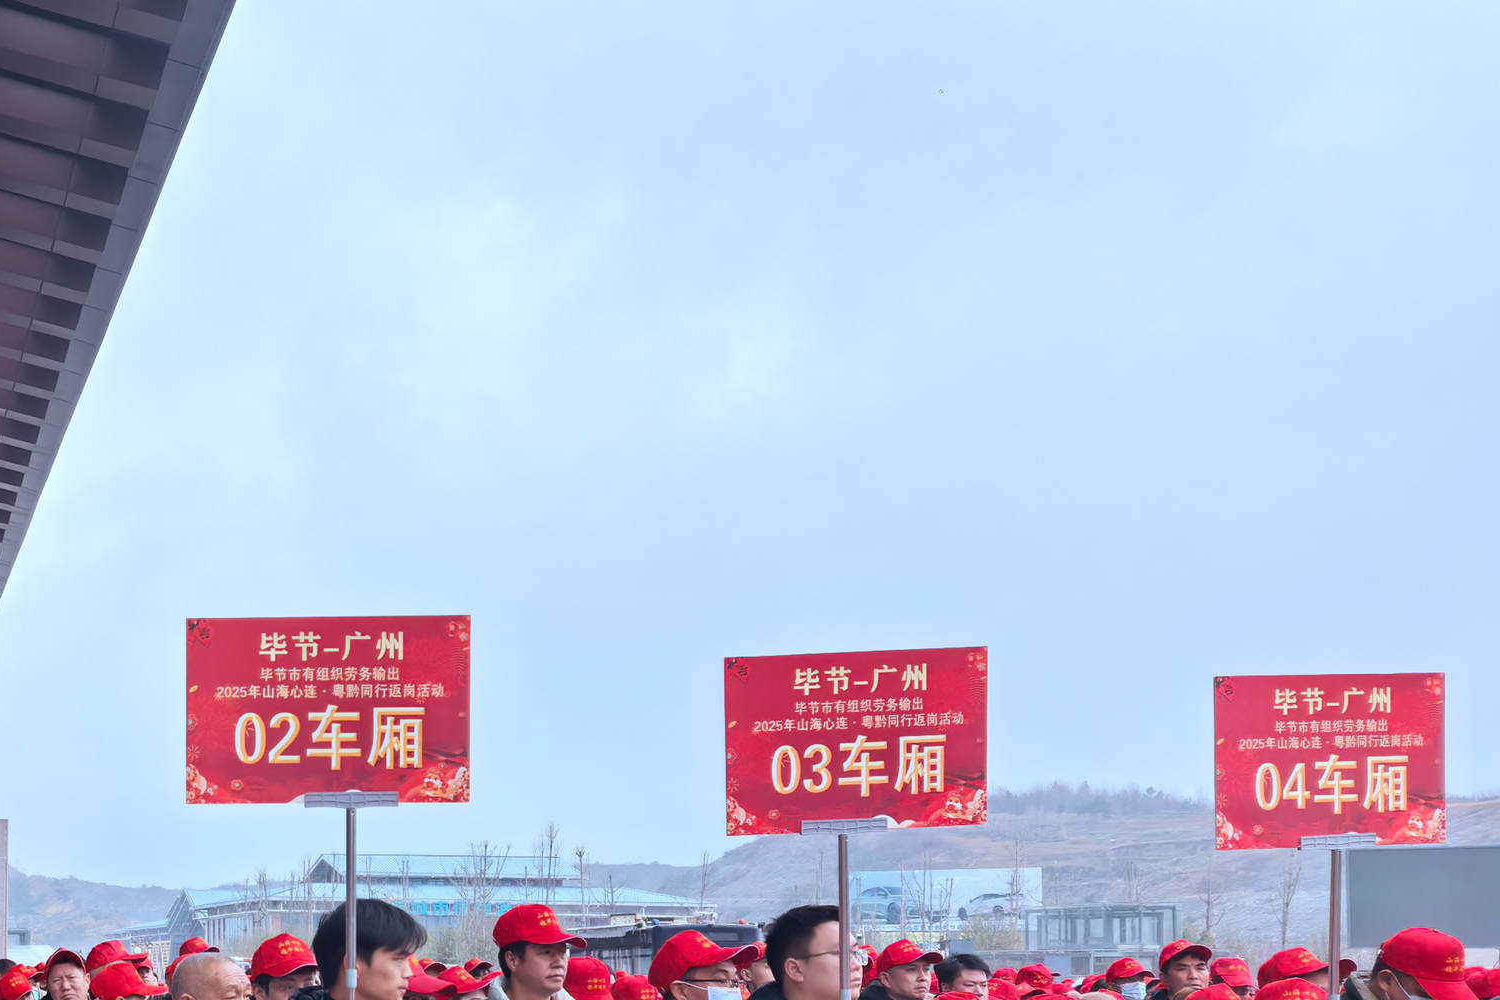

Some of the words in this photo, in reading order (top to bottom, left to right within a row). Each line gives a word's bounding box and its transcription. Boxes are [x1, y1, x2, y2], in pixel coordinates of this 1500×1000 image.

[259, 666, 400, 682] 毕节市有组织劳务输出
[794, 697, 924, 715] 毕节市有组织劳务输出
[234, 704, 426, 770] 02车厢
[1275, 719, 1388, 734] 毕节市有组织劳务输出
[771, 734, 947, 797] 03车厢
[1255, 753, 1409, 815] 04车厢
